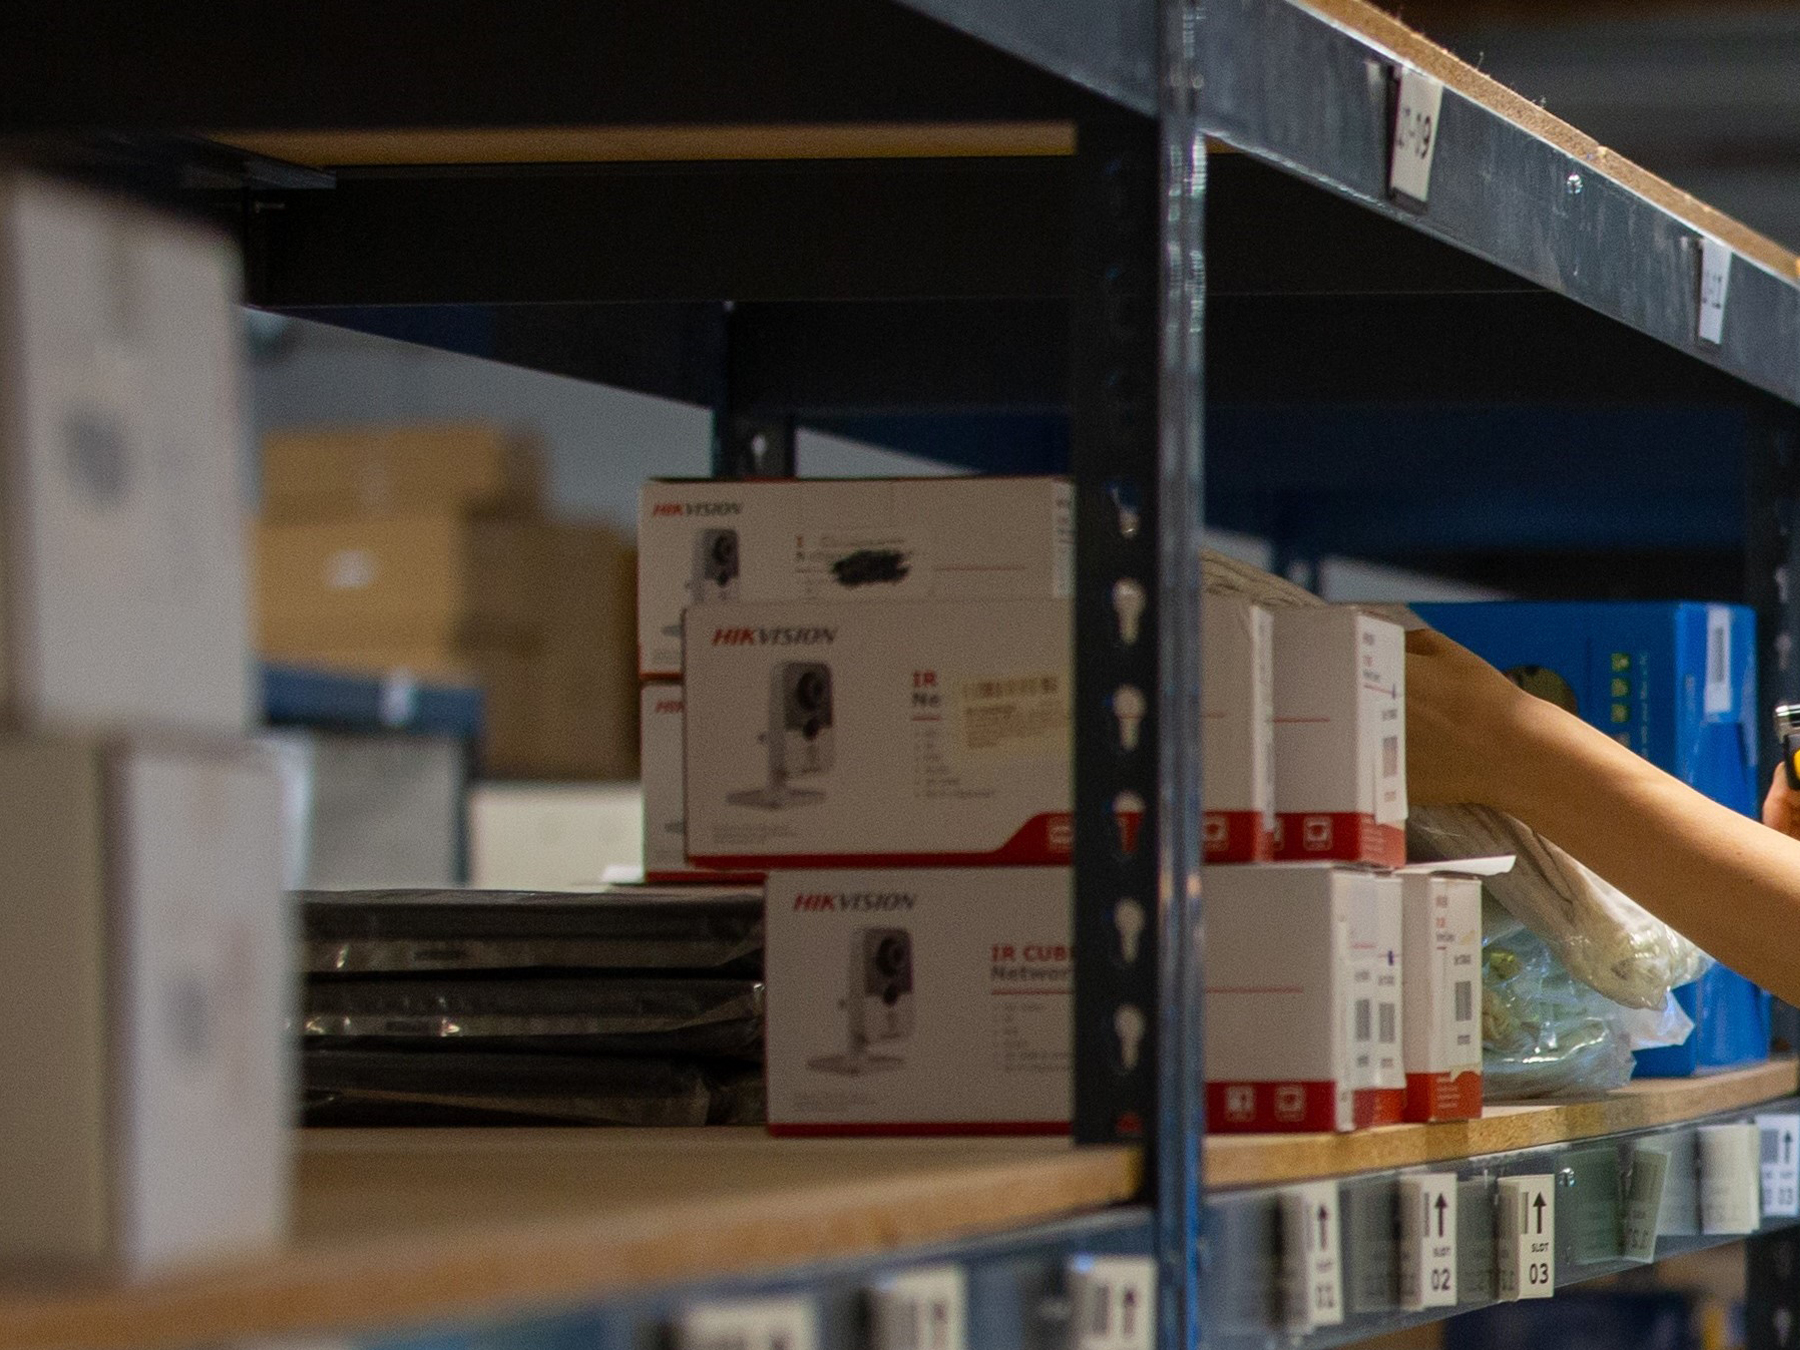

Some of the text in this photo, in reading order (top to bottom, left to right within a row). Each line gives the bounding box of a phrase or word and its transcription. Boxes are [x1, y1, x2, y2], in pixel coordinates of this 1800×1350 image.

[653, 502, 742, 516] HIKVISION
[713, 628, 837, 645] HIKVISION
[794, 893, 916, 911] HIKVISION
[992, 945, 1015, 962] IR
[1531, 1242, 1549, 1253] SLOT
[1431, 1268, 1451, 1291] 02
[1529, 1263, 1549, 1284] 03
